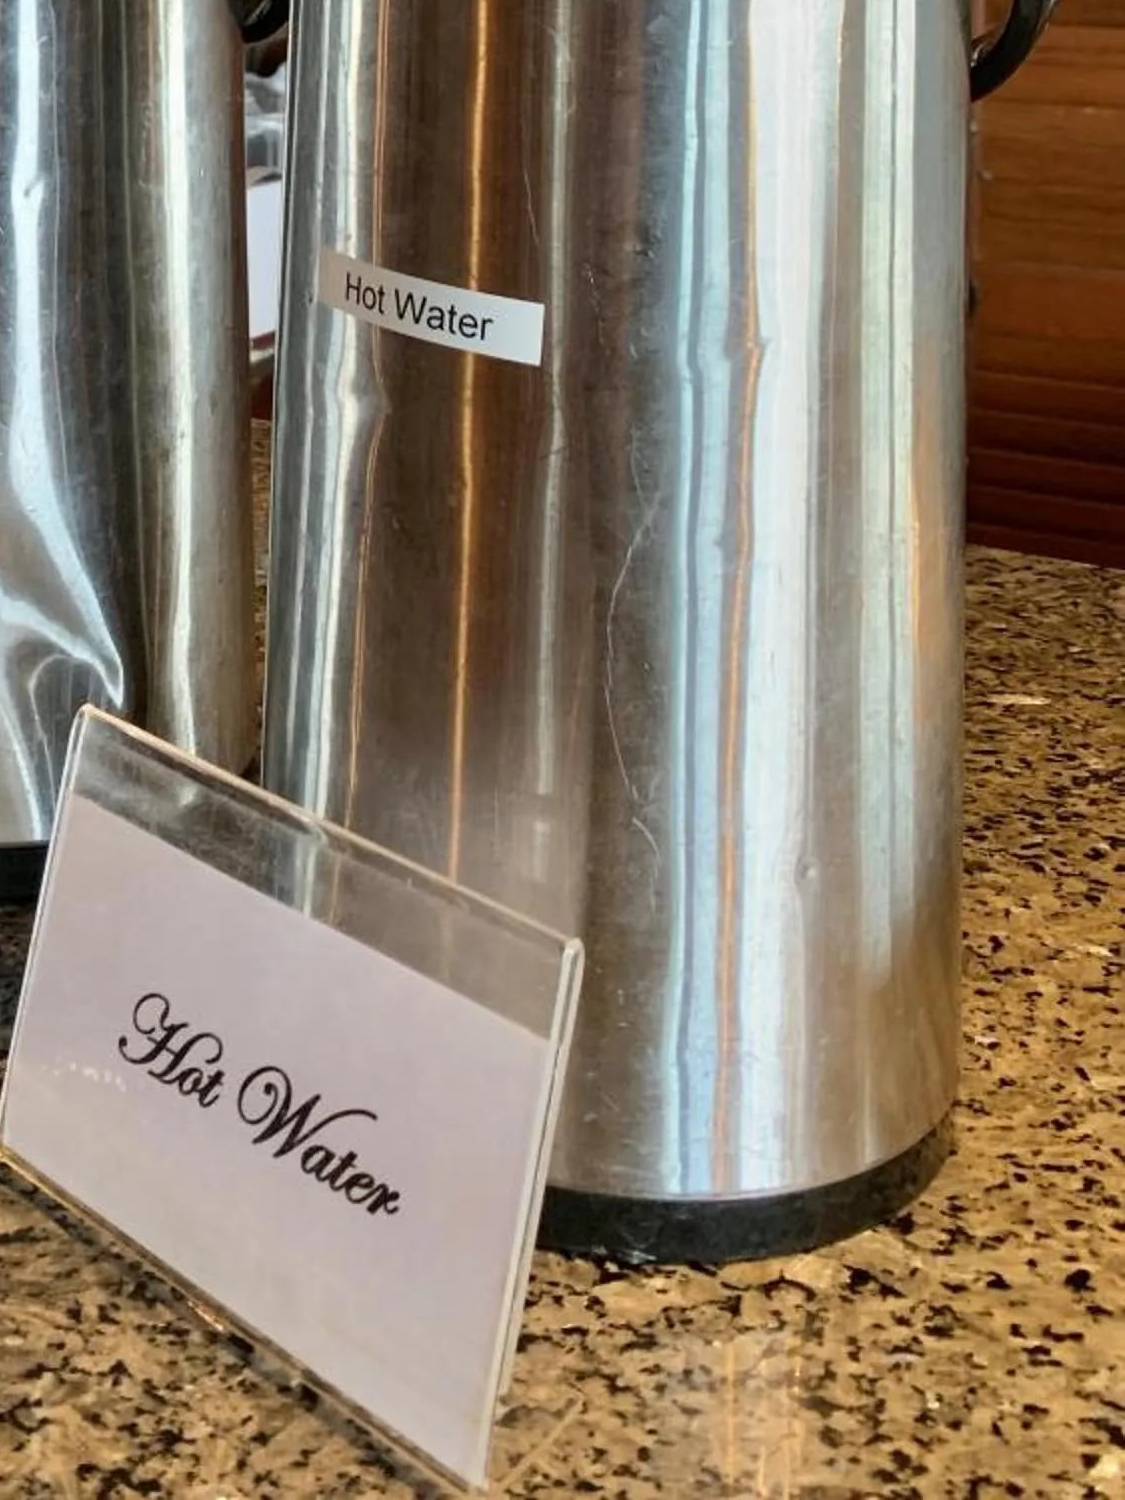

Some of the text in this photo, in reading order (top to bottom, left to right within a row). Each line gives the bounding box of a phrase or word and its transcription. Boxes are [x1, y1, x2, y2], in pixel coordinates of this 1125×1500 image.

[345, 271, 495, 341] Hot Water
[118, 992, 401, 1215] Hot Water
